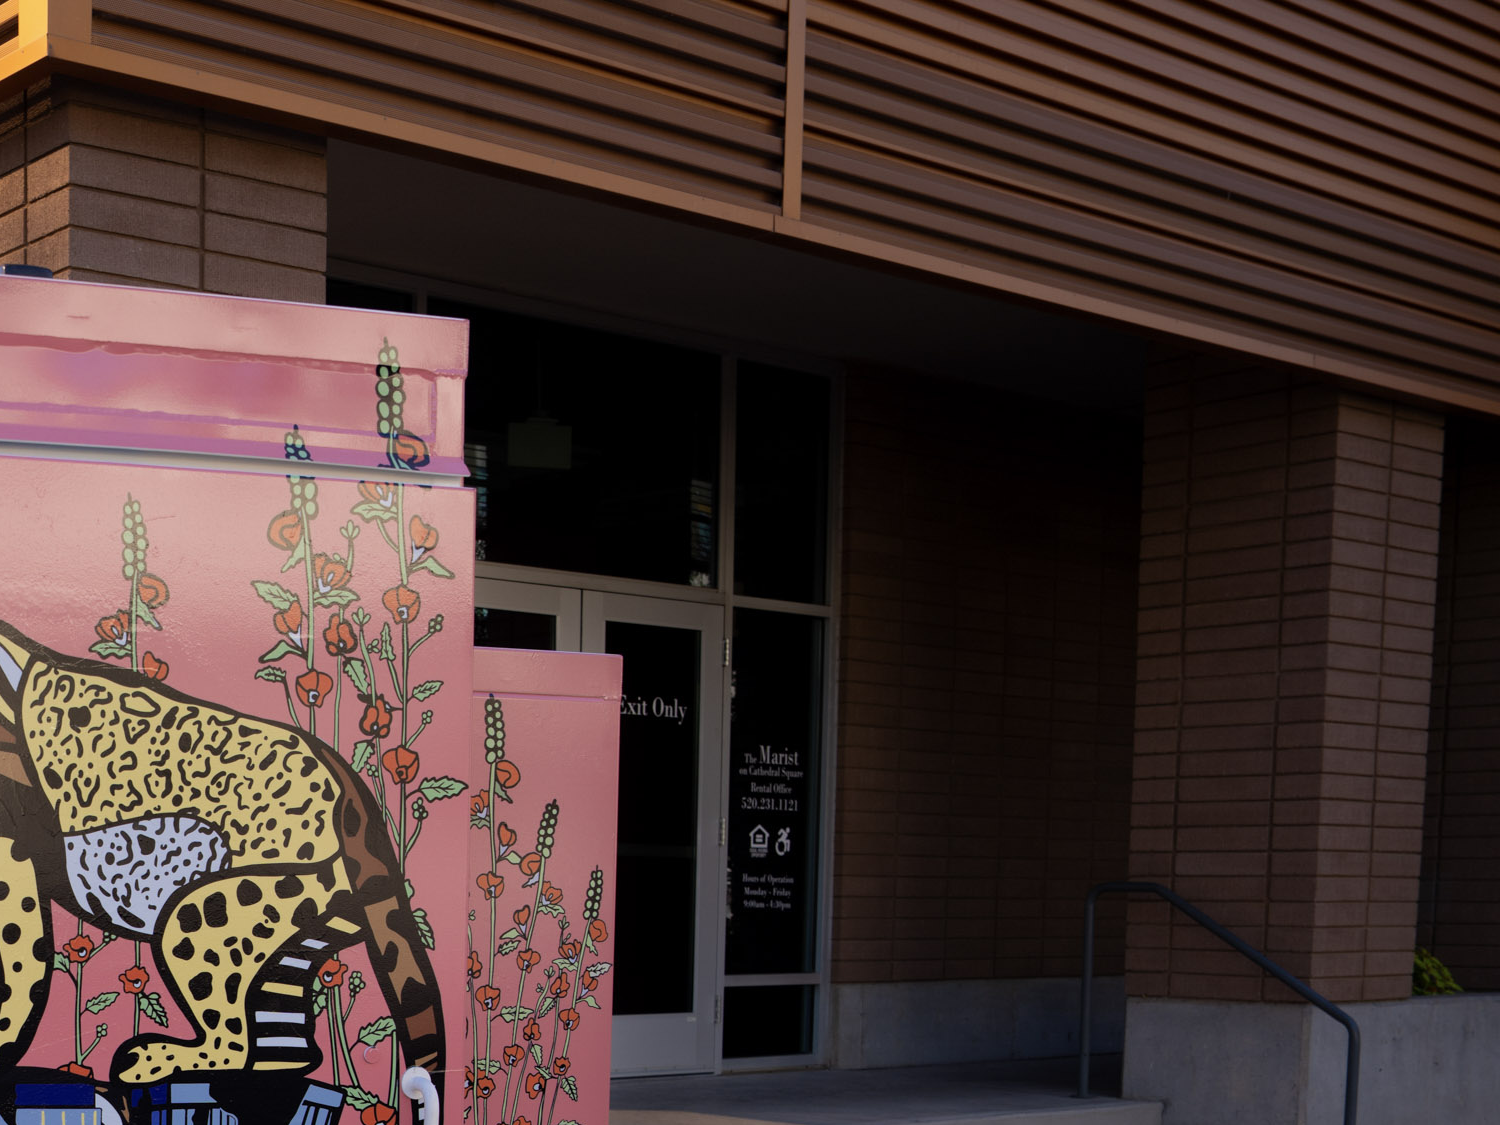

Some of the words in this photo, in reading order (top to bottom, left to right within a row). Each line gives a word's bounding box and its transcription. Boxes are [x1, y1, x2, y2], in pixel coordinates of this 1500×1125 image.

[620, 694, 648, 716] Exit
[652, 696, 688, 726] Only
[744, 752, 757, 764] The
[759, 744, 799, 766] Marist
[739, 767, 748, 776] on
[748, 765, 780, 777] Cathedral
[781, 766, 804, 781] Square
[750, 782, 772, 793] Rental
[772, 783, 793, 794] Office
[740, 796, 799, 812] 520.231.1121
